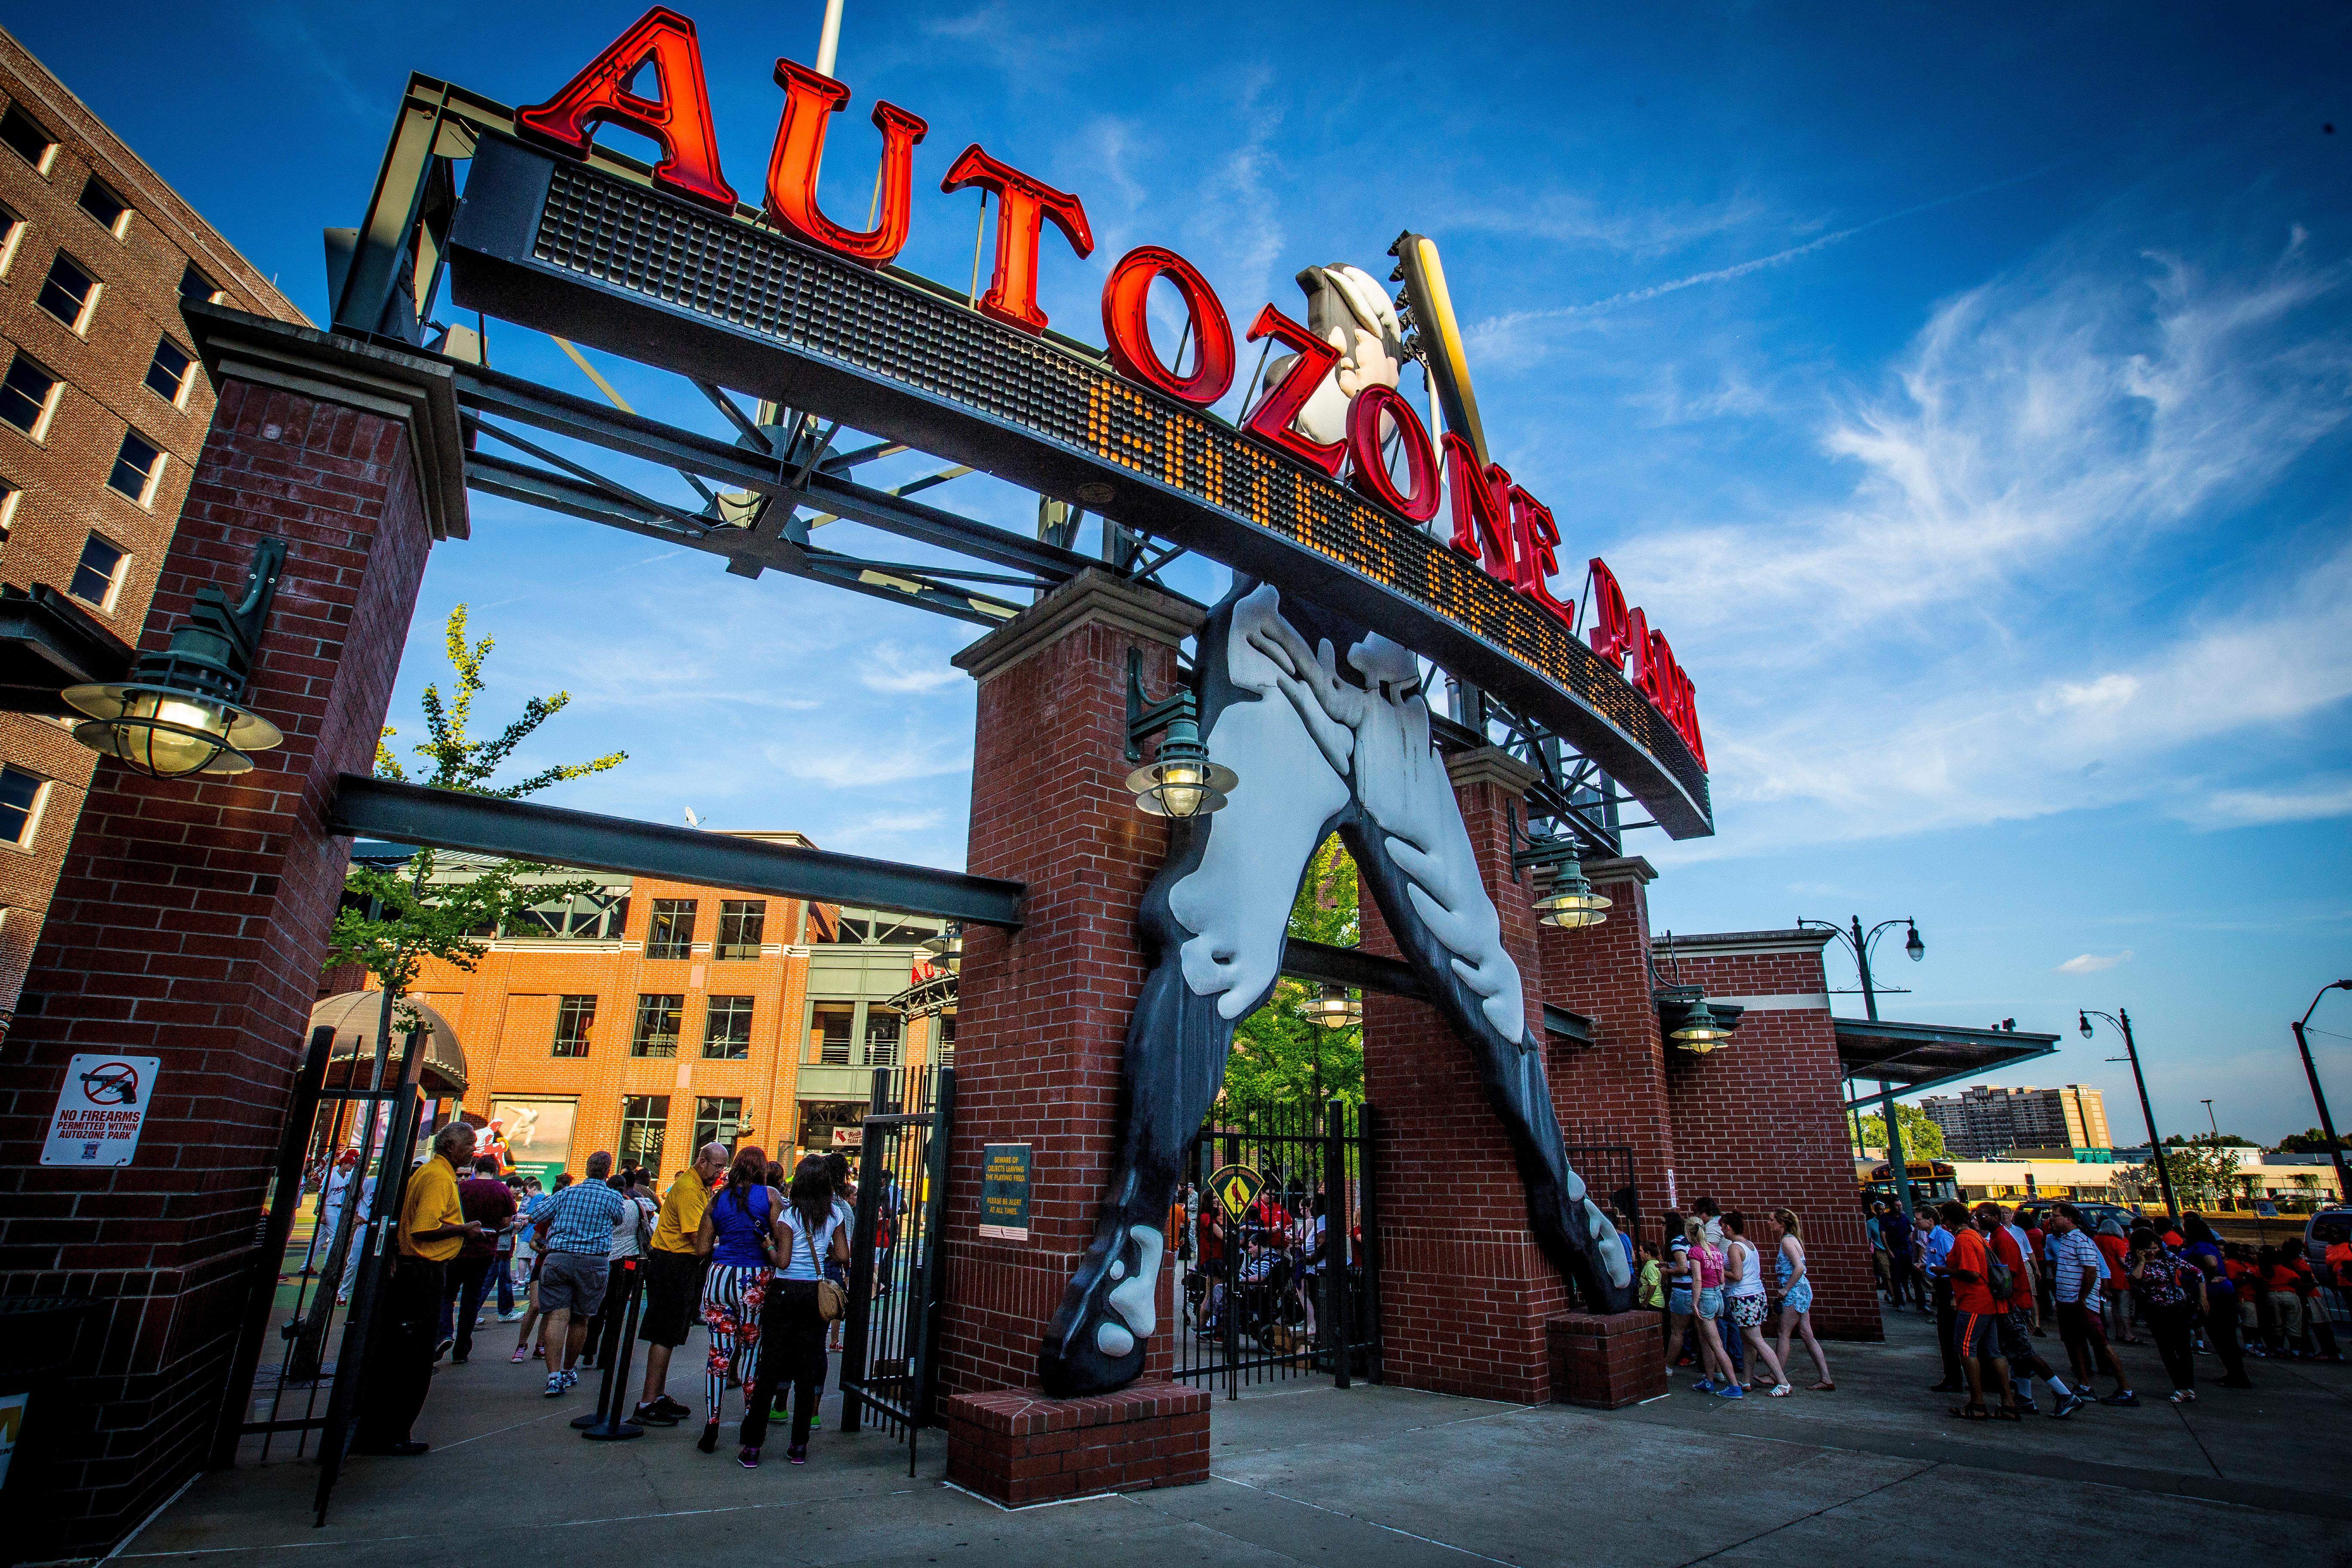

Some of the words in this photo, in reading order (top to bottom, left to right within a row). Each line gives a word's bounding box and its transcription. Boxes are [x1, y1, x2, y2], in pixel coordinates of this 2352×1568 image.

[514, 5, 1575, 631] AUTOZONE
[1589, 557, 1709, 774] PARK
[1427, 548, 1572, 693] OPEN
[59, 1109, 78, 1121] NO
[80, 1110, 141, 1123] FIREARMS
[56, 1121, 105, 1130] PERMITTED
[107, 1123, 138, 1131] WITHIN
[58, 1130, 106, 1139] AUTOZONE
[107, 1131, 132, 1140] PARK
